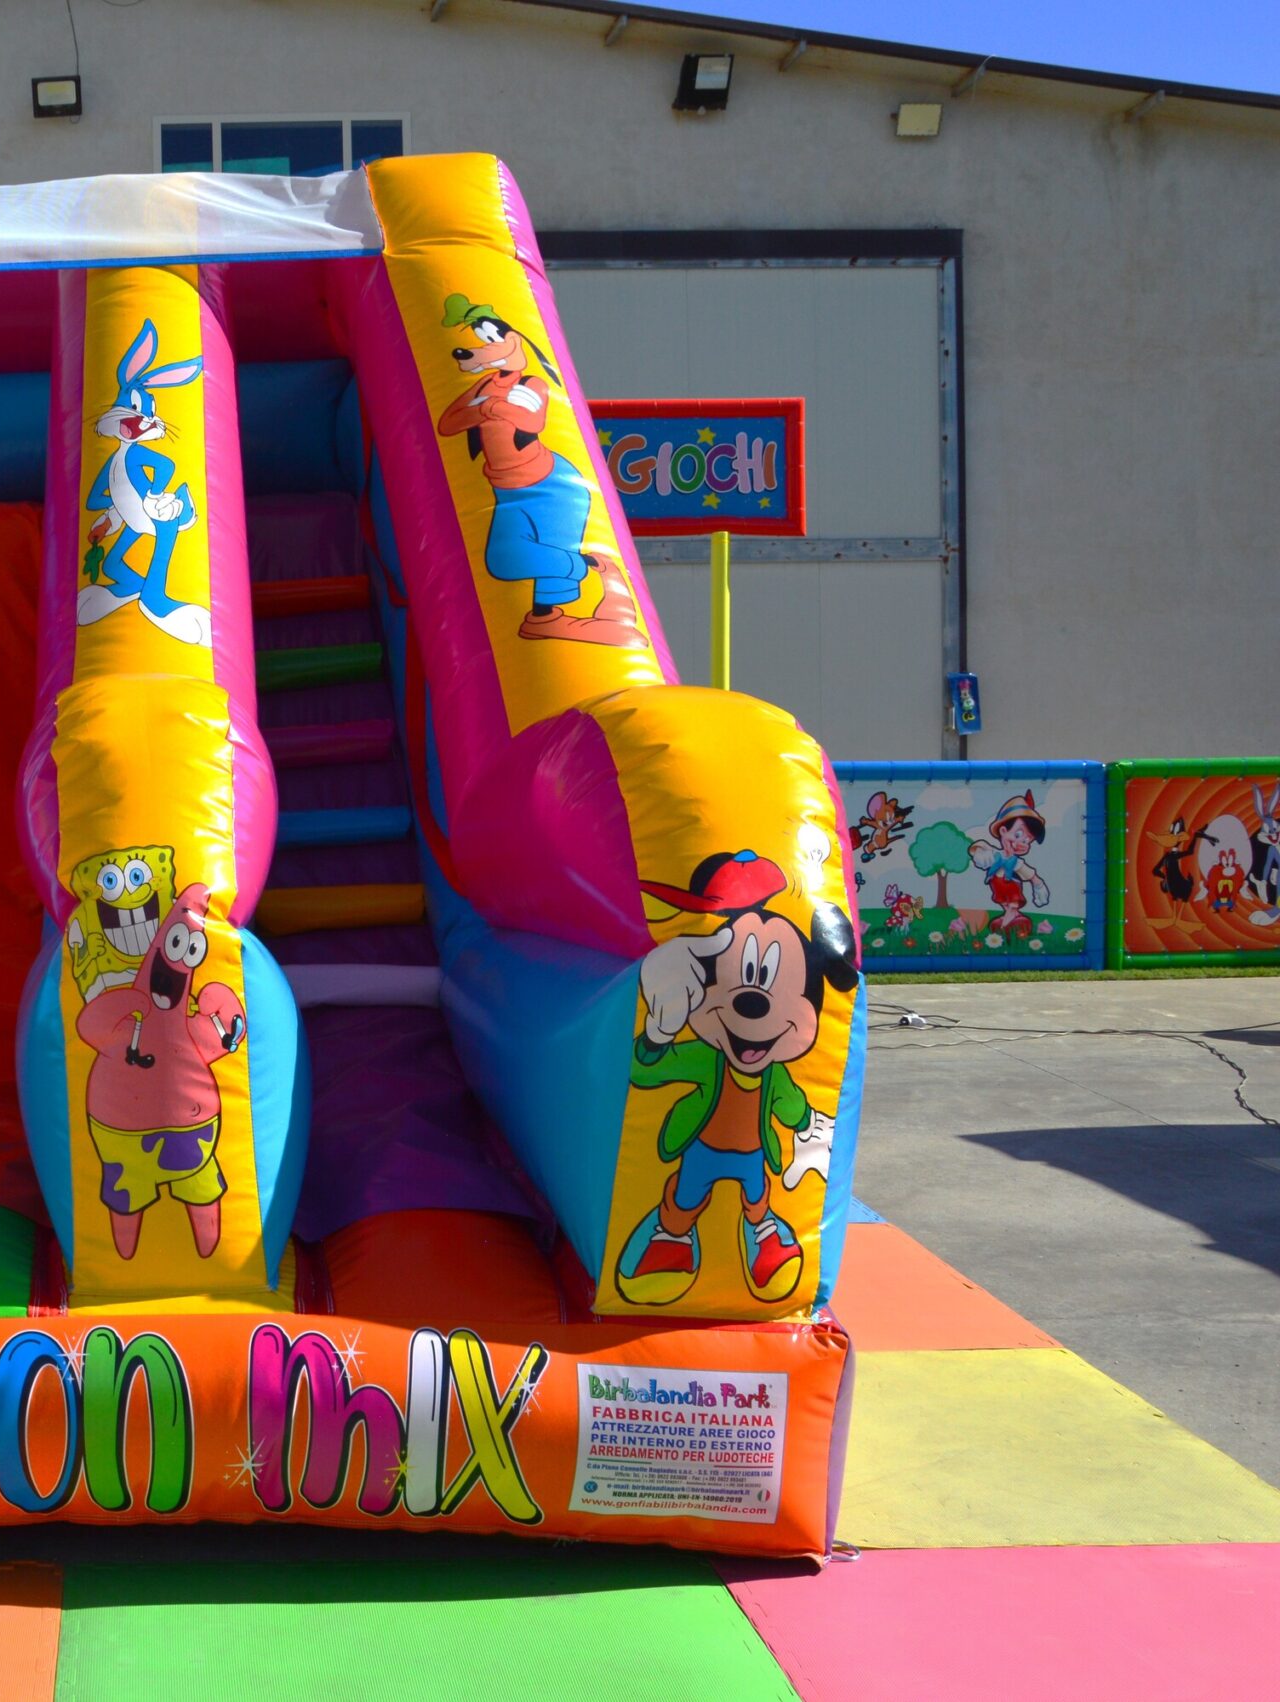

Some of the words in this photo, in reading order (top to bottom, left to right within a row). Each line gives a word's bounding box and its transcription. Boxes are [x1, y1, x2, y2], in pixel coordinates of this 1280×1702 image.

[607, 431, 777, 496] GIOCHI
[588, 1374, 717, 1408] Birbalandia
[720, 1383, 770, 1408] Park
[592, 1406, 685, 1424] FABBRICA
[691, 1413, 773, 1426] ITALIANA
[591, 1421, 695, 1437] ATTREZZATURE
[700, 1428, 732, 1438] AREE
[737, 1429, 776, 1439] GIOCO
[591, 1433, 618, 1444] PER
[622, 1436, 685, 1448] INTERNO
[690, 1440, 707, 1449] ED
[711, 1441, 772, 1451] ESTERNO
[589, 1445, 679, 1461] ARREDAMENTO
[683, 1450, 705, 1462] PER
[709, 1452, 775, 1463] LUDOTECHE
[581, 1498, 767, 1514] www.gonfiabilibirbalandia.com
